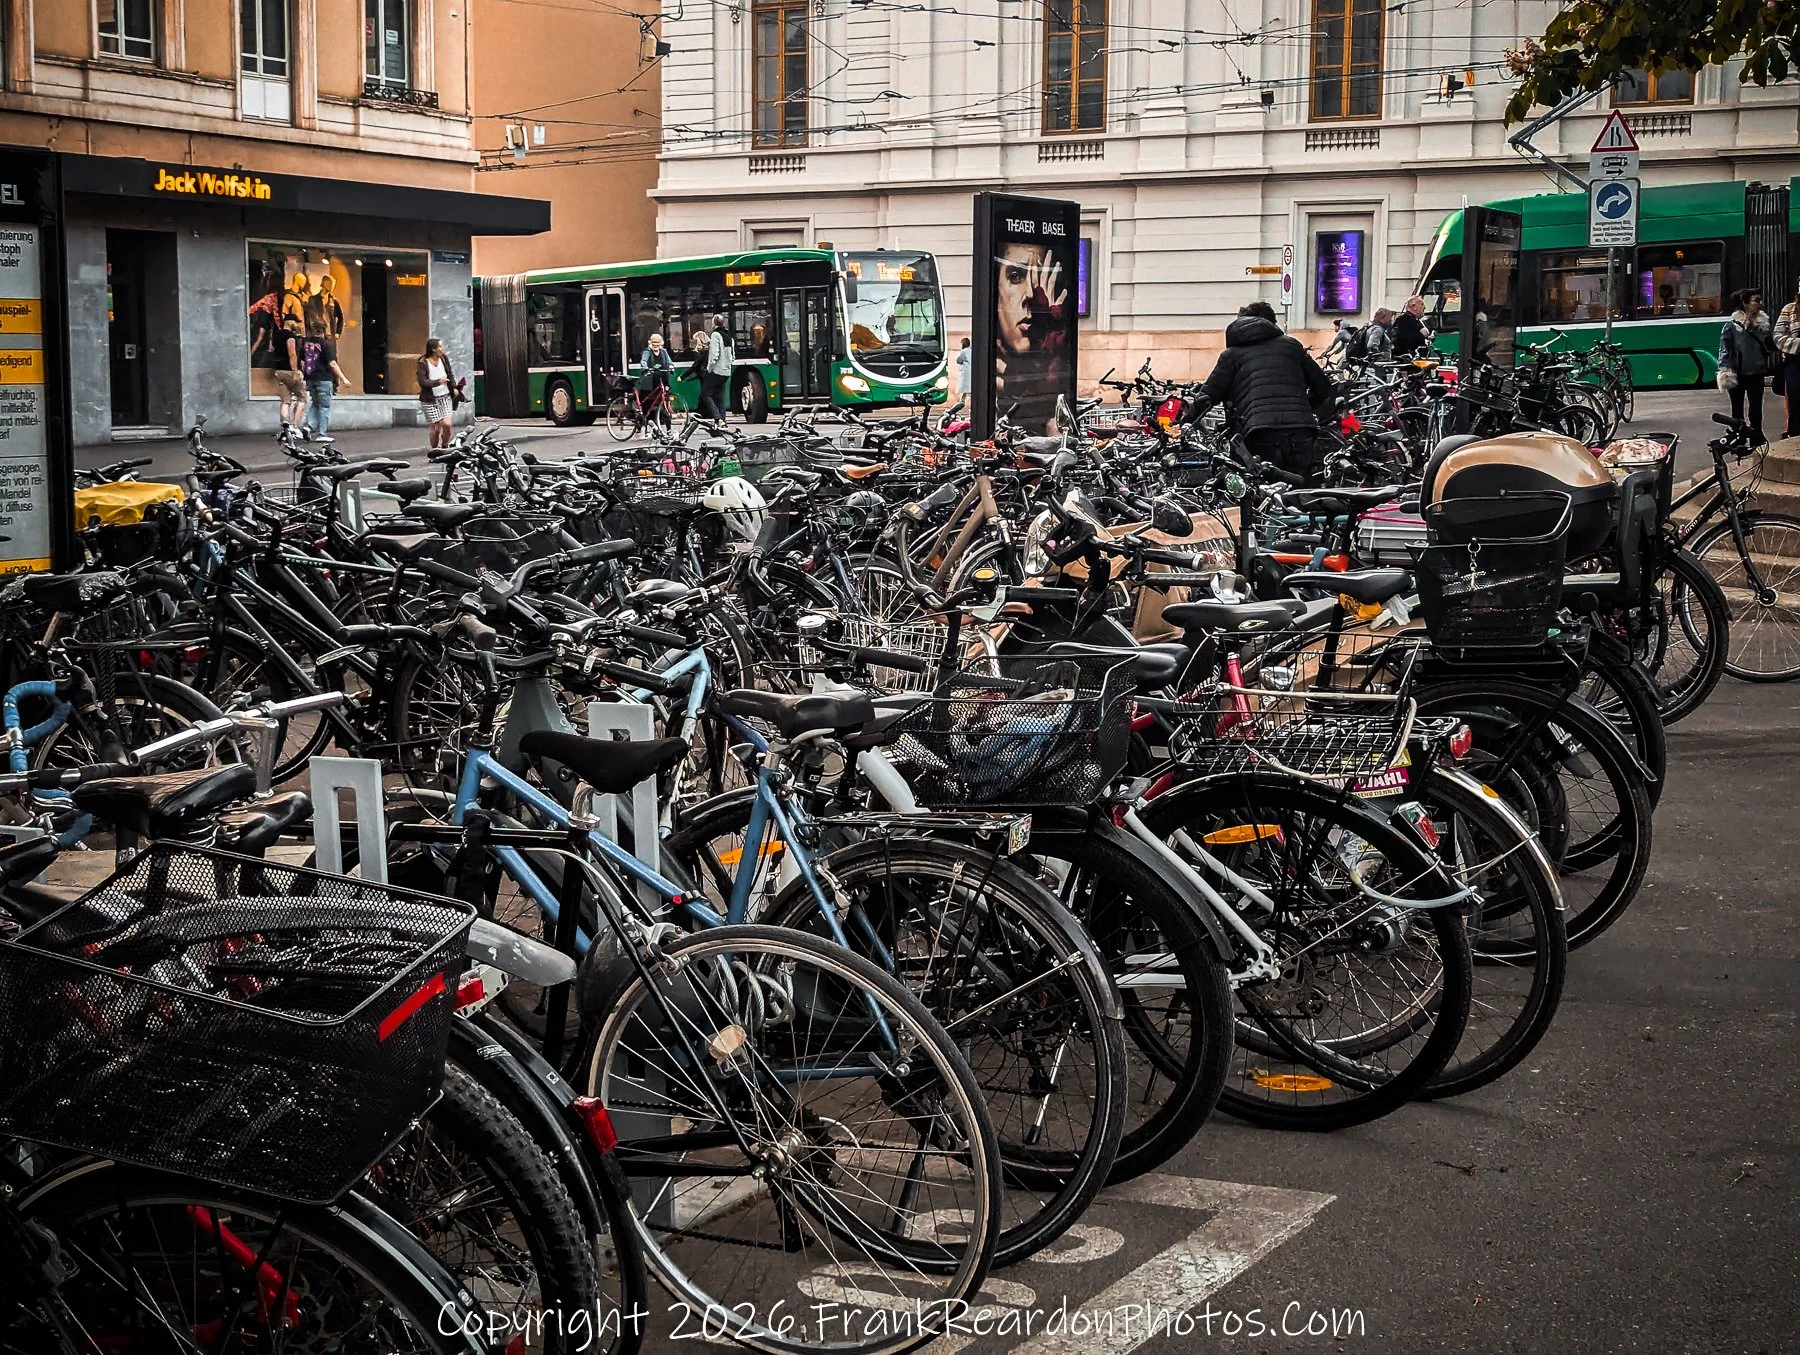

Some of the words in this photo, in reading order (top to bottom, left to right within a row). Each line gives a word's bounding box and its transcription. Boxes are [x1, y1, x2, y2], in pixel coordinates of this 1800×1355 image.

[154, 168, 196, 193] Jack
[196, 172, 271, 199] Wolfskin
[1006, 218, 1035, 233] THEATER
[1042, 221, 1066, 236] BASEL
